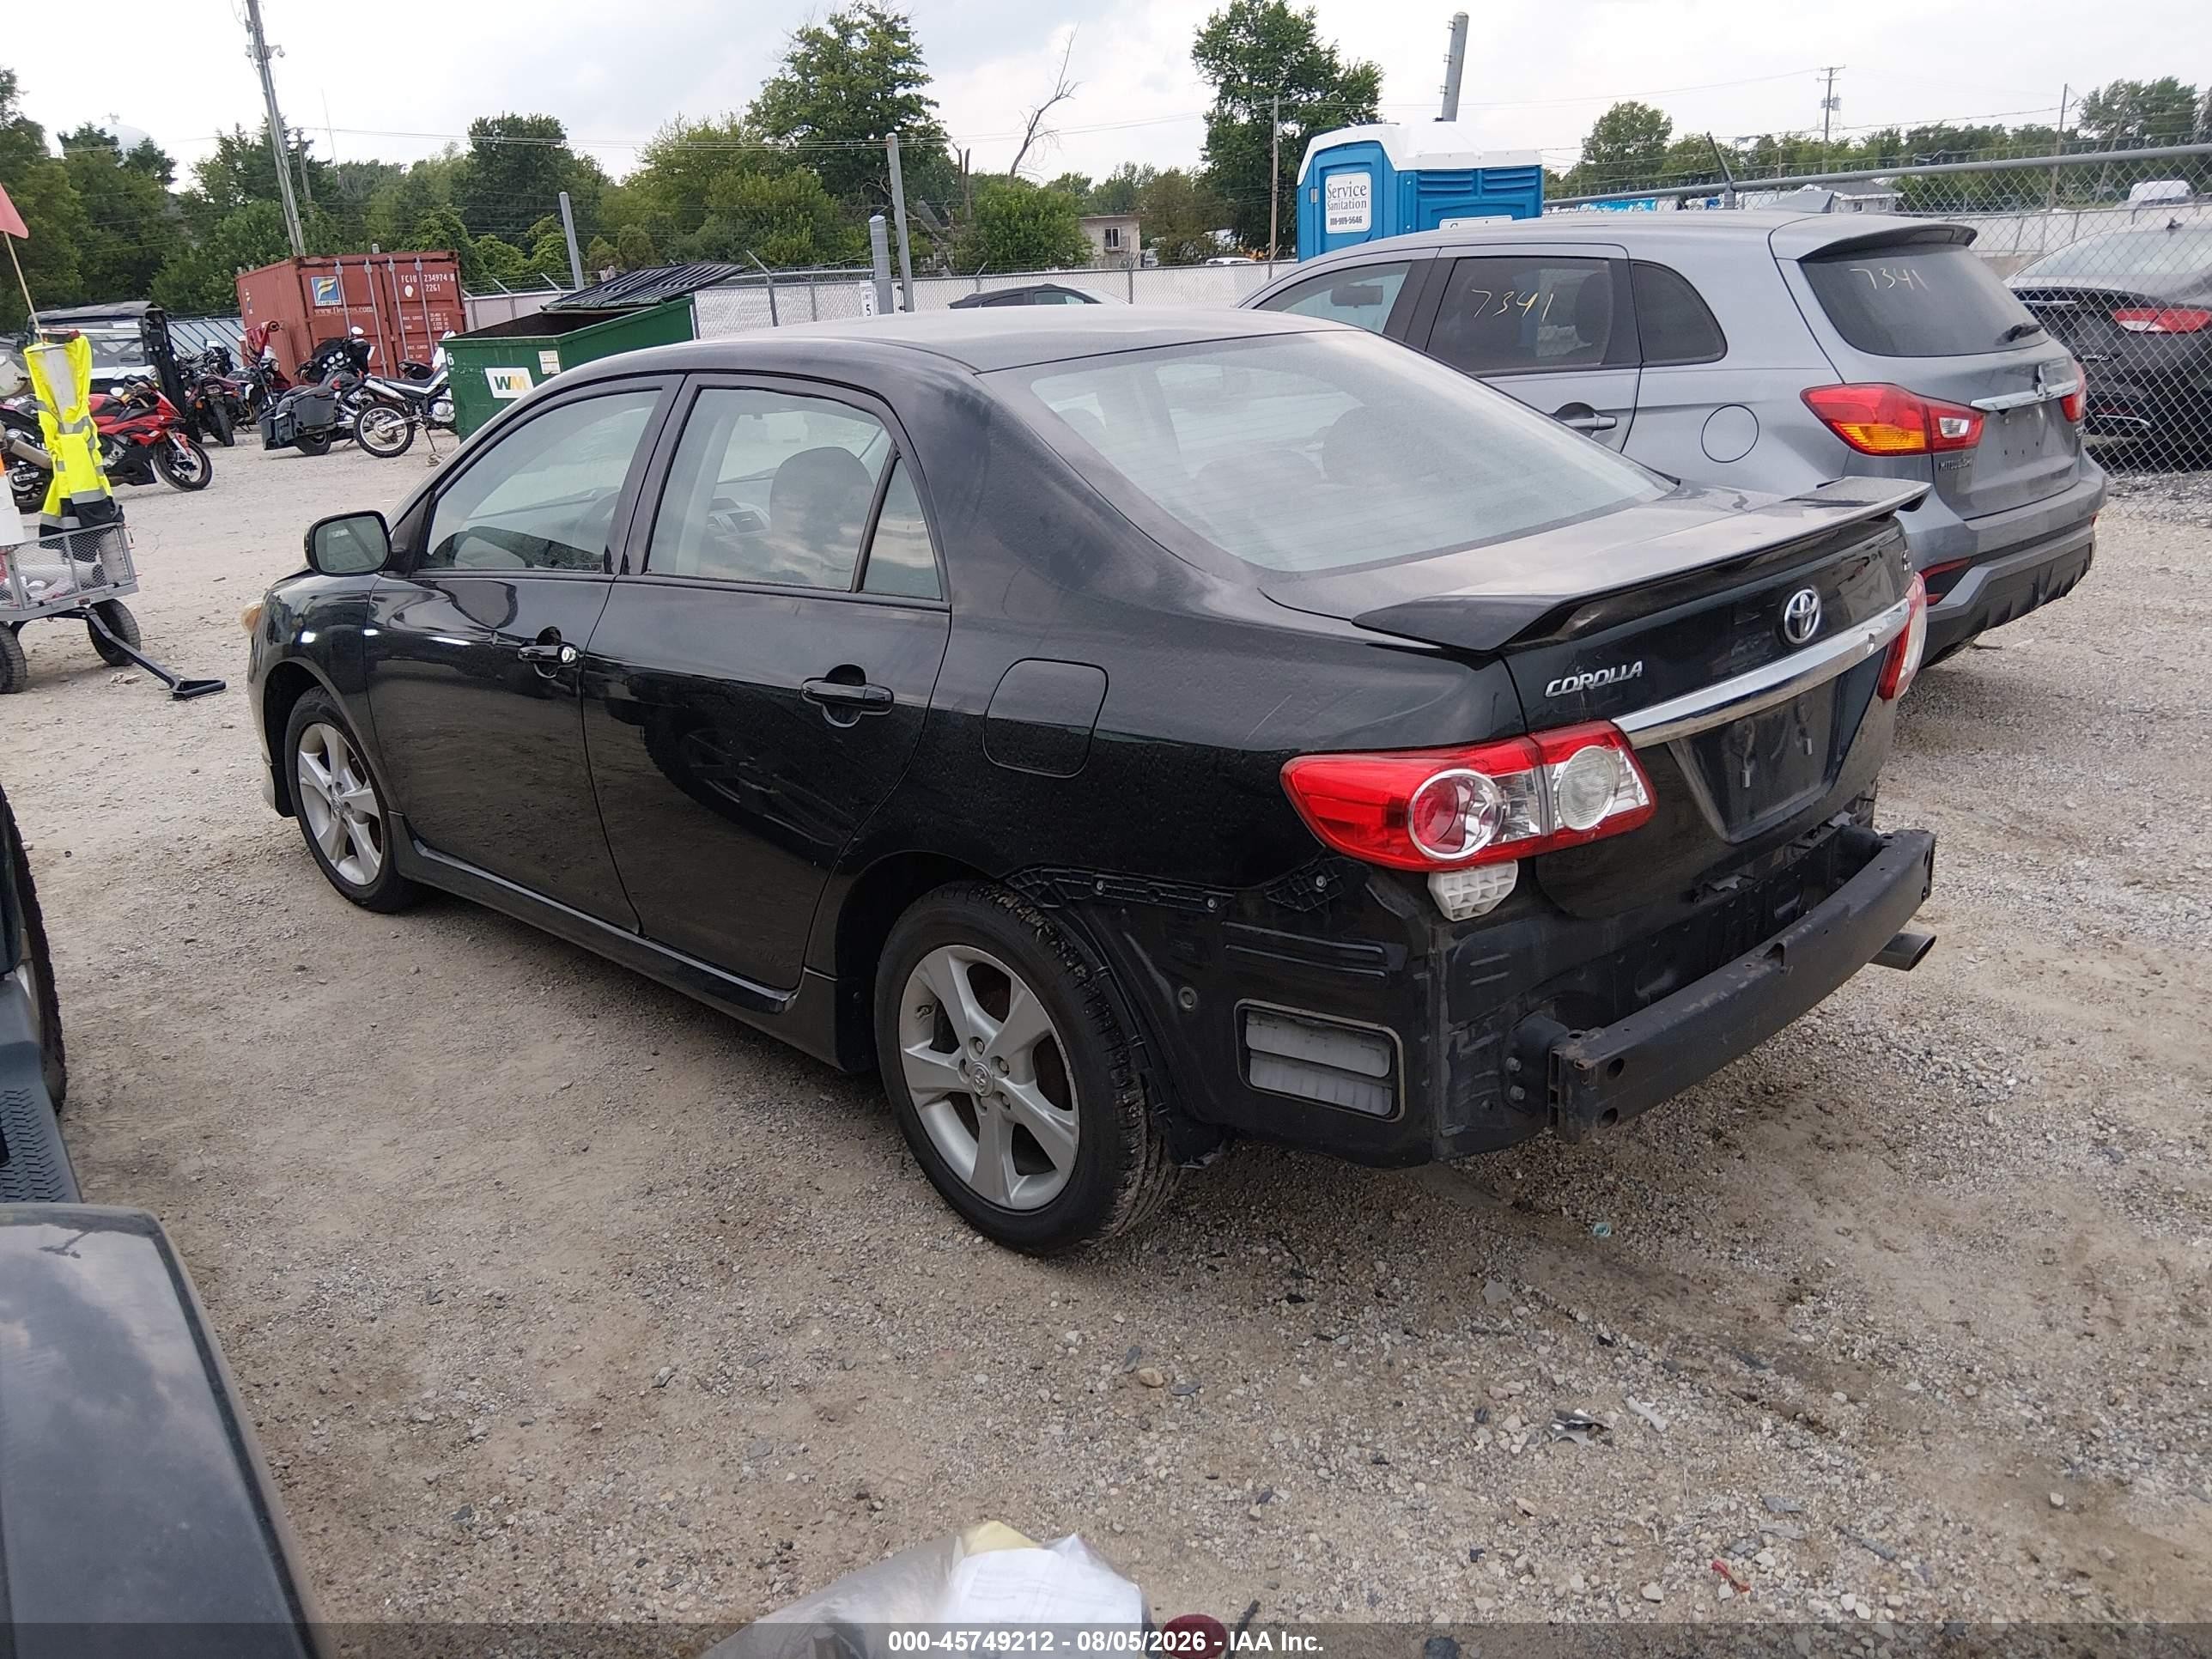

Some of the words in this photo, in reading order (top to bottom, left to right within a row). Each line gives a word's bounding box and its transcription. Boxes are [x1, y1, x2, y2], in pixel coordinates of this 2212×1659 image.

[1327, 181, 1368, 199] Service
[1327, 198, 1367, 212] Sanitation
[1850, 267, 1930, 292] 7341
[866, 304, 872, 316] 5
[1471, 289, 1554, 322] 7341
[447, 352, 454, 365] 6
[494, 376, 528, 391] WM
[1545, 660, 1643, 698] COROLLA
